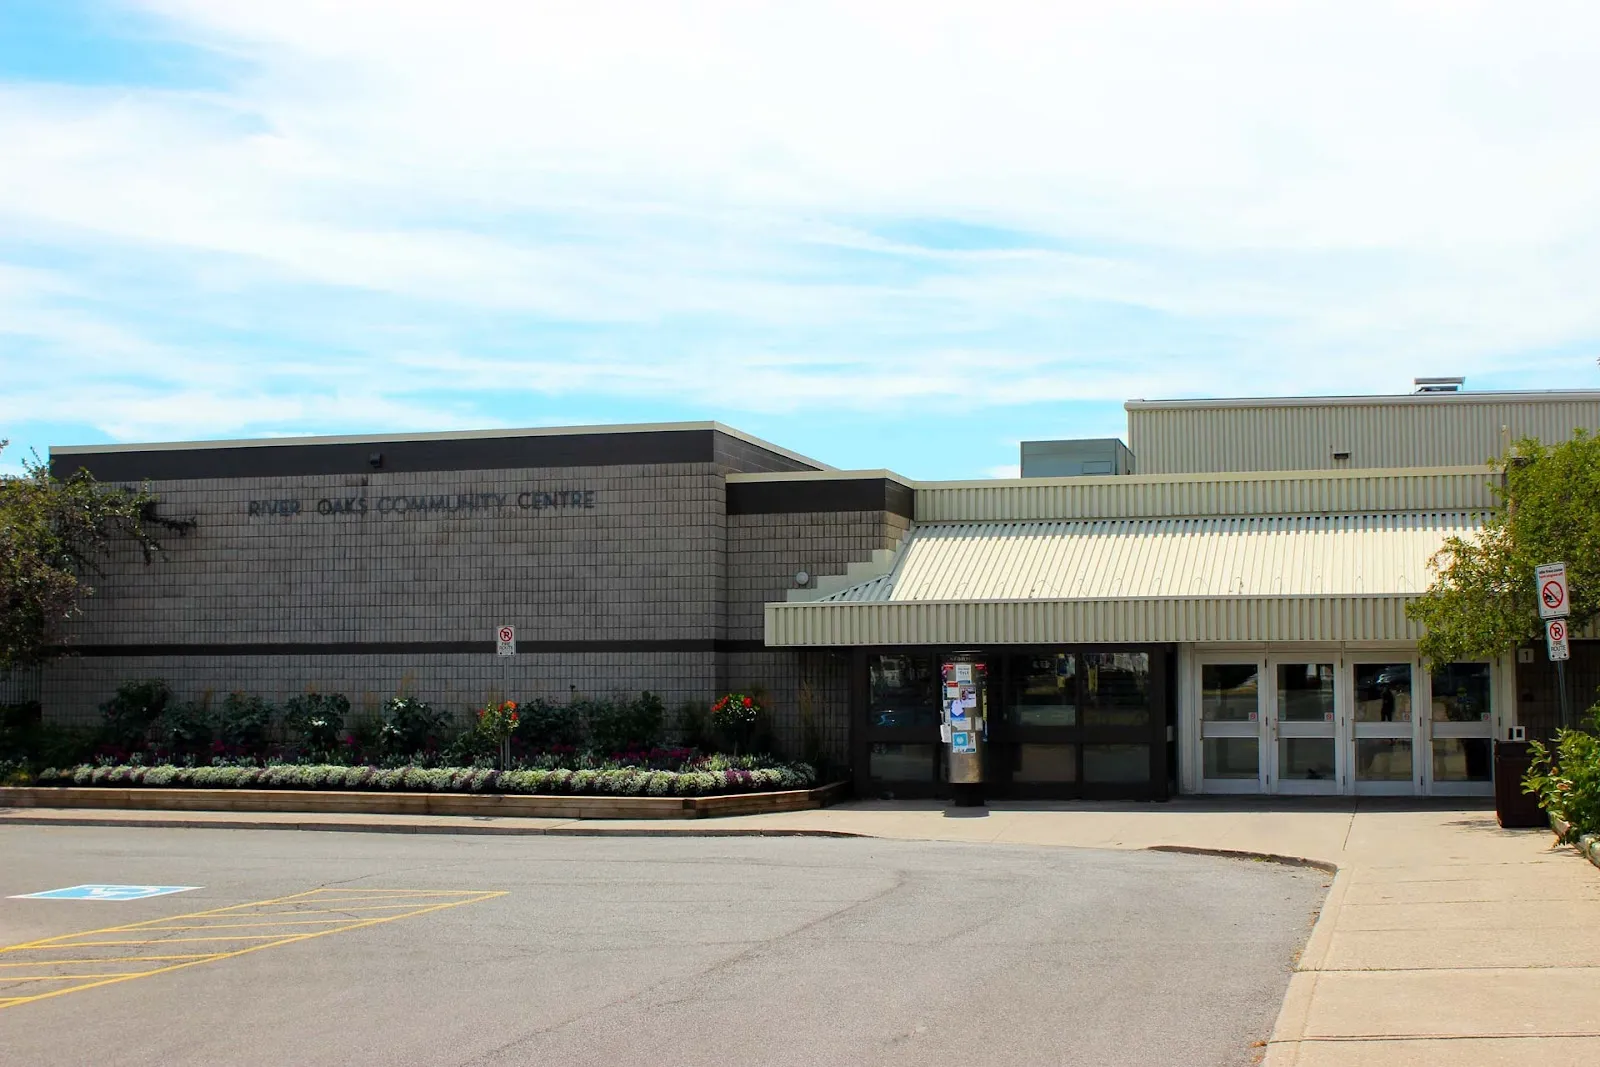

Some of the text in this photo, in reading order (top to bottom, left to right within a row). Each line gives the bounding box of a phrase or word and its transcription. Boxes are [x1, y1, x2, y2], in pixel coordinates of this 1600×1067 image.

[249, 489, 595, 517] RIVER OAKS COMMUNITY CENTRE
